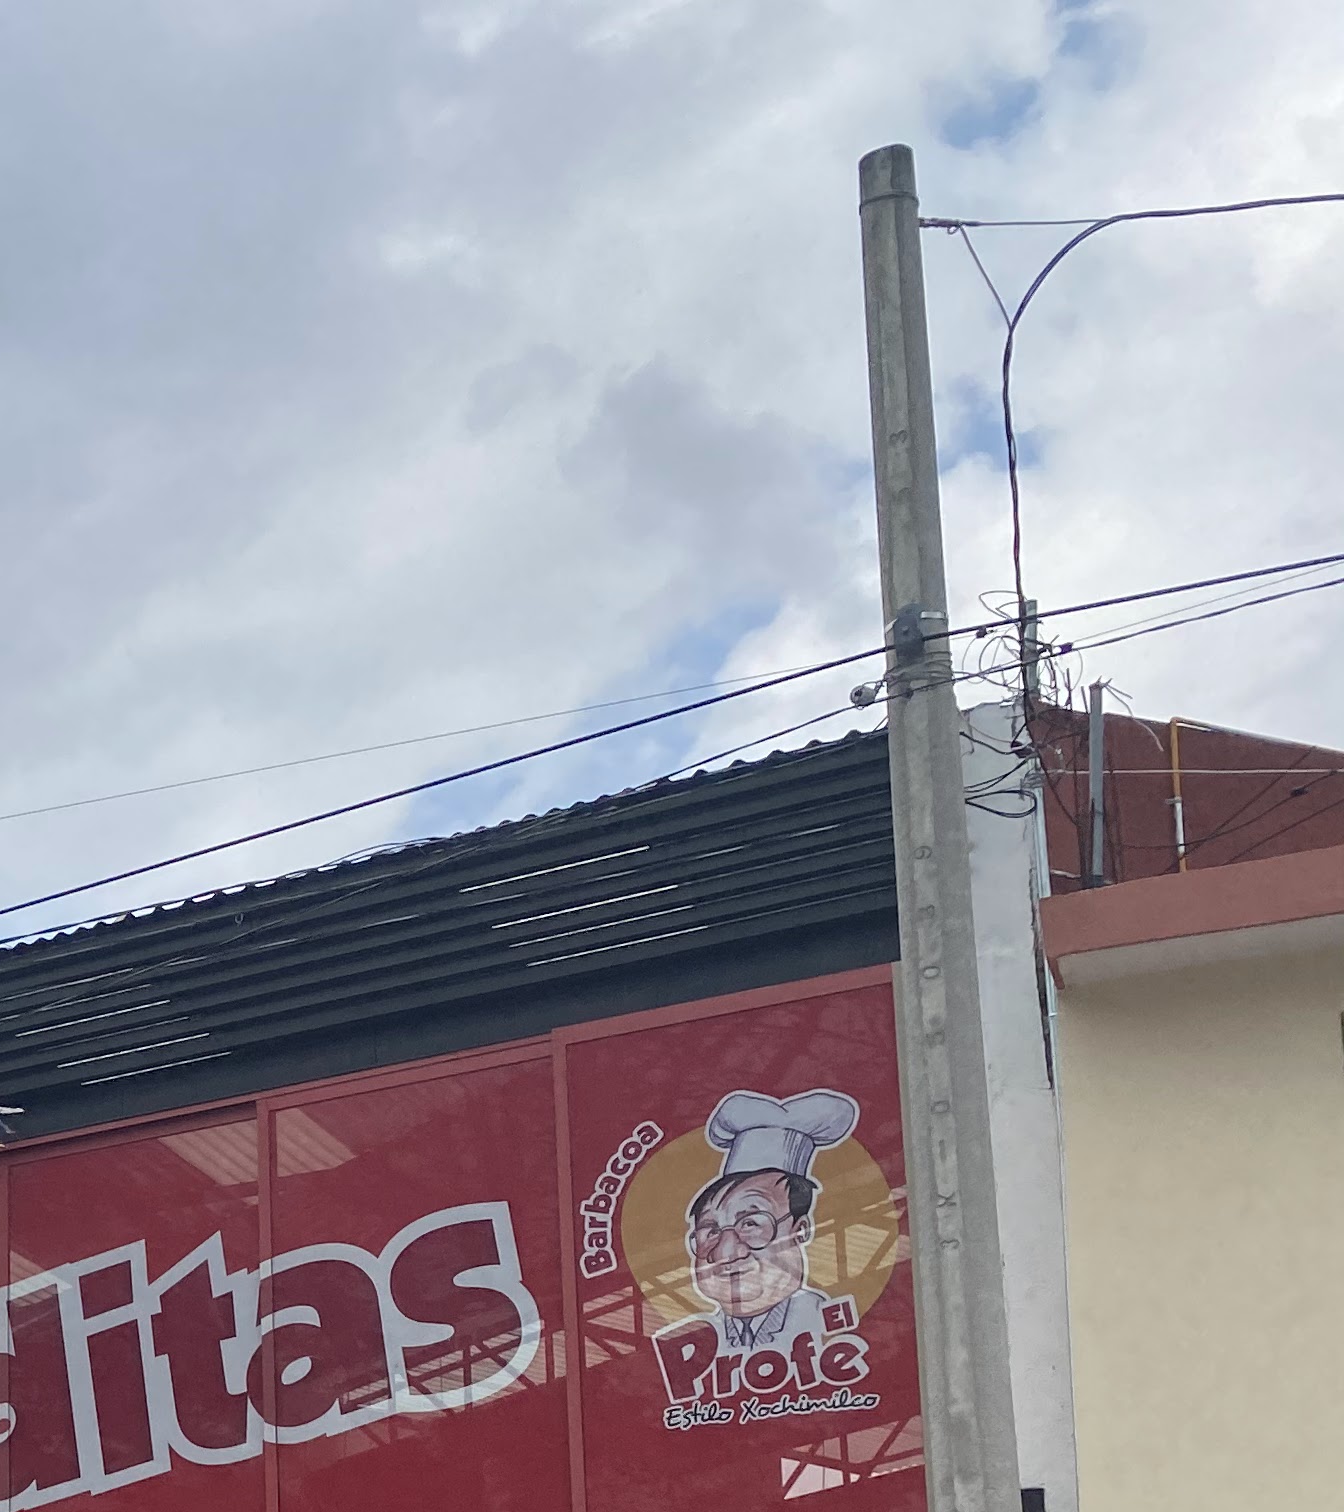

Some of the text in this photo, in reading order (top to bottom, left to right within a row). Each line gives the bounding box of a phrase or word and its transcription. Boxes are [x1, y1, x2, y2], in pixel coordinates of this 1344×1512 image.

[582, 1121, 662, 1278] Barbacoa
[654, 1320, 870, 1403] Profe
[665, 1390, 879, 1430] Estilo Xochimilco
